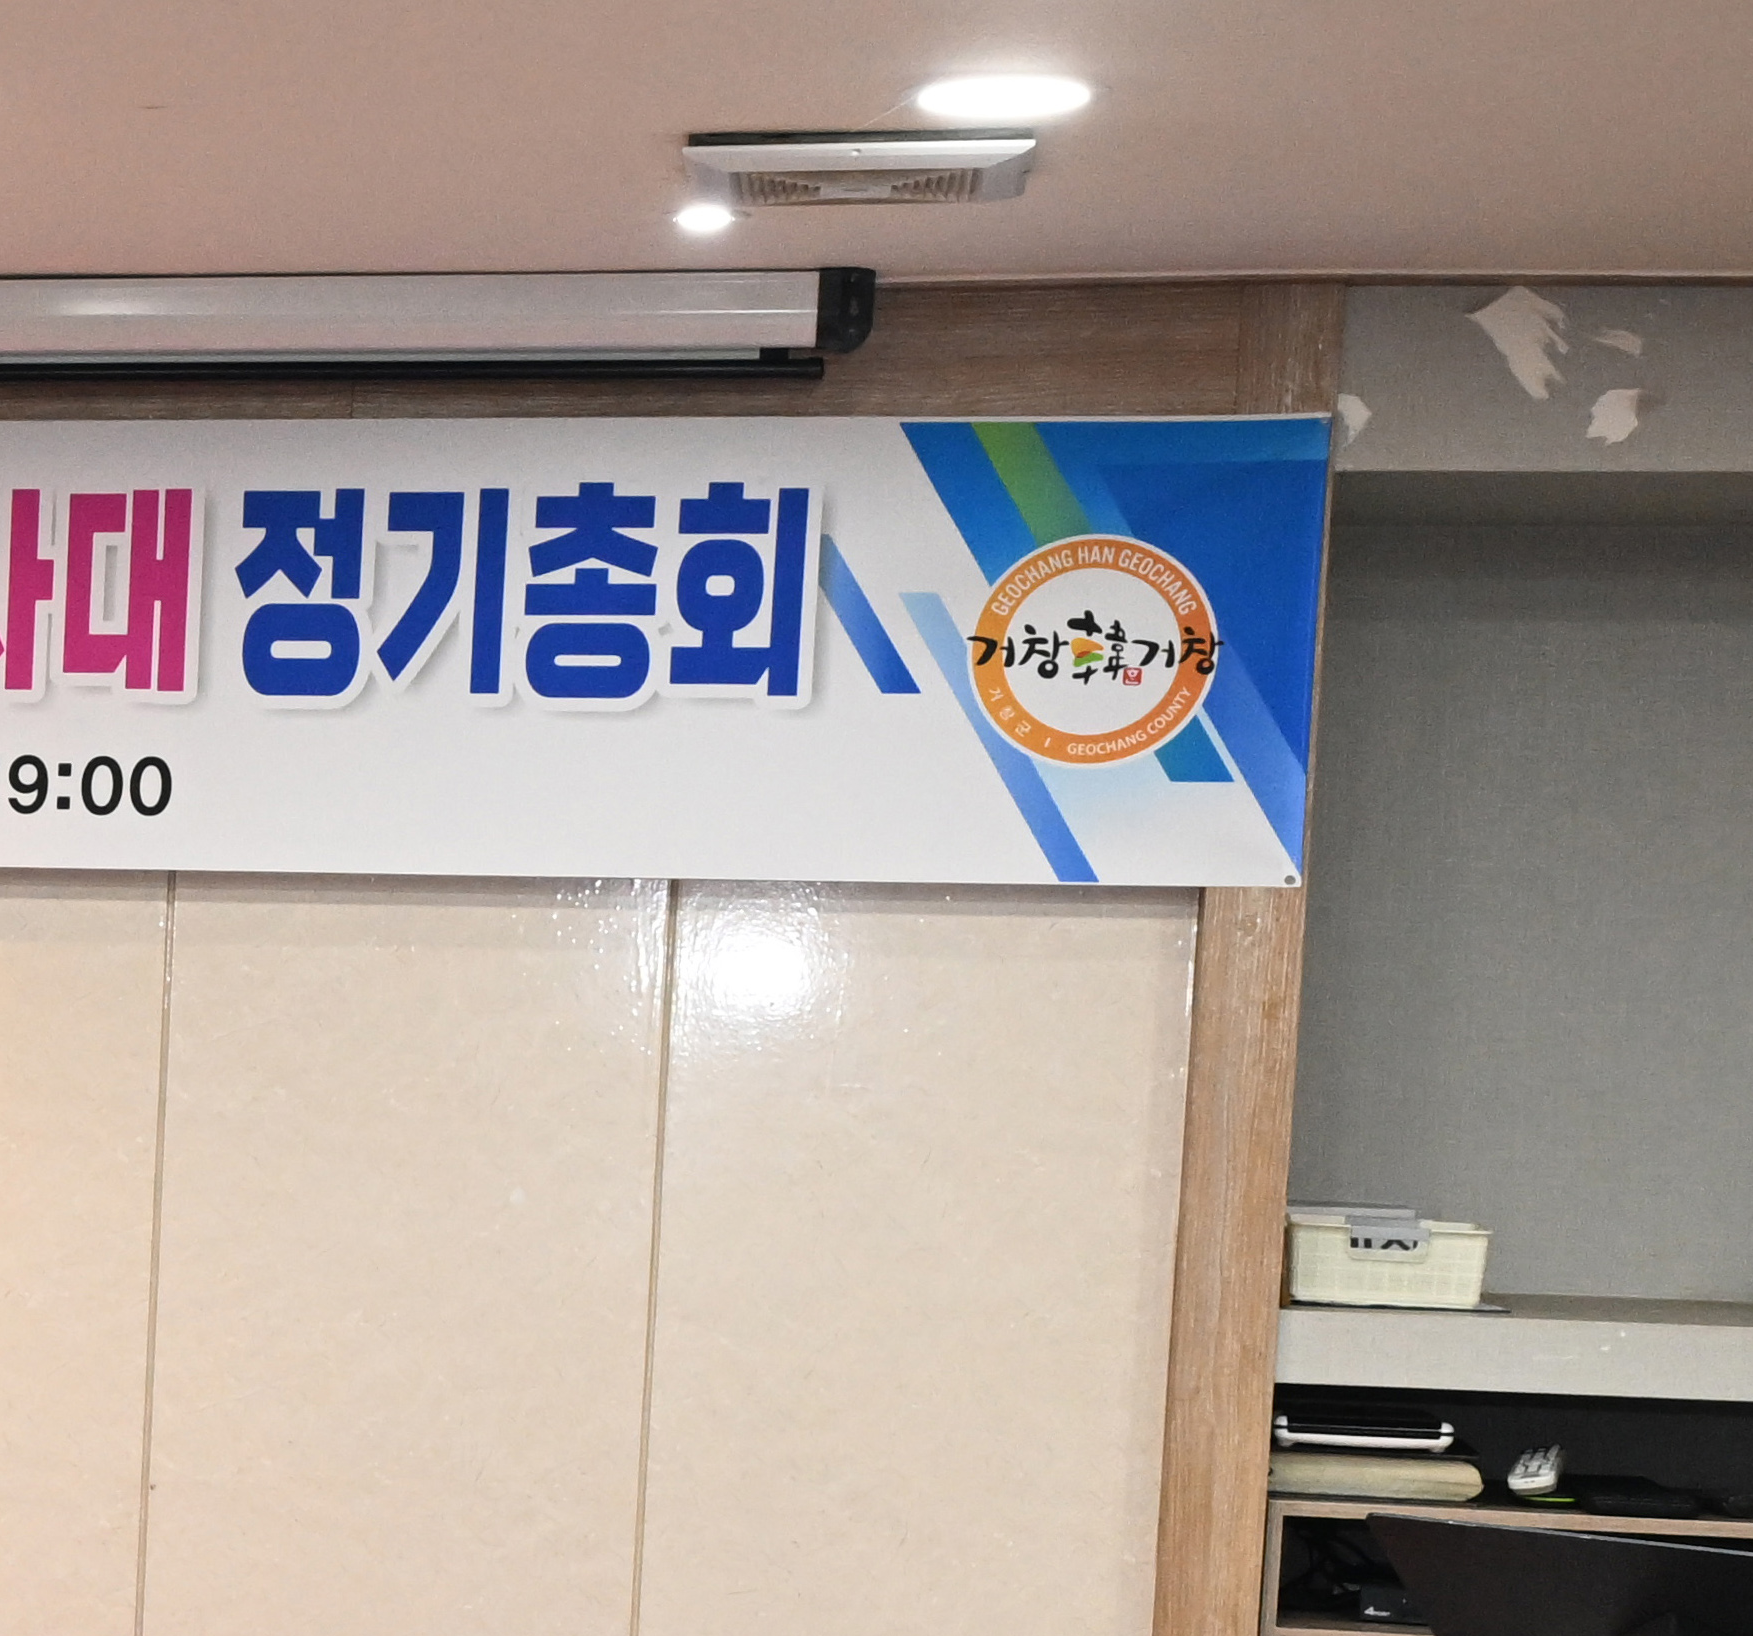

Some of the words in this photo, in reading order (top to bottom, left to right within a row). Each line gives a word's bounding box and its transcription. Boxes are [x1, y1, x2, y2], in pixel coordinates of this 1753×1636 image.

[237, 482, 809, 698] 정기총회
[990, 546, 1074, 617] GEOCHANG
[1077, 544, 1116, 565] HAN
[1117, 548, 1198, 616] GEOCHANG
[1066, 729, 1148, 757] GEOCHANG
[1146, 686, 1193, 735] COUNTY
